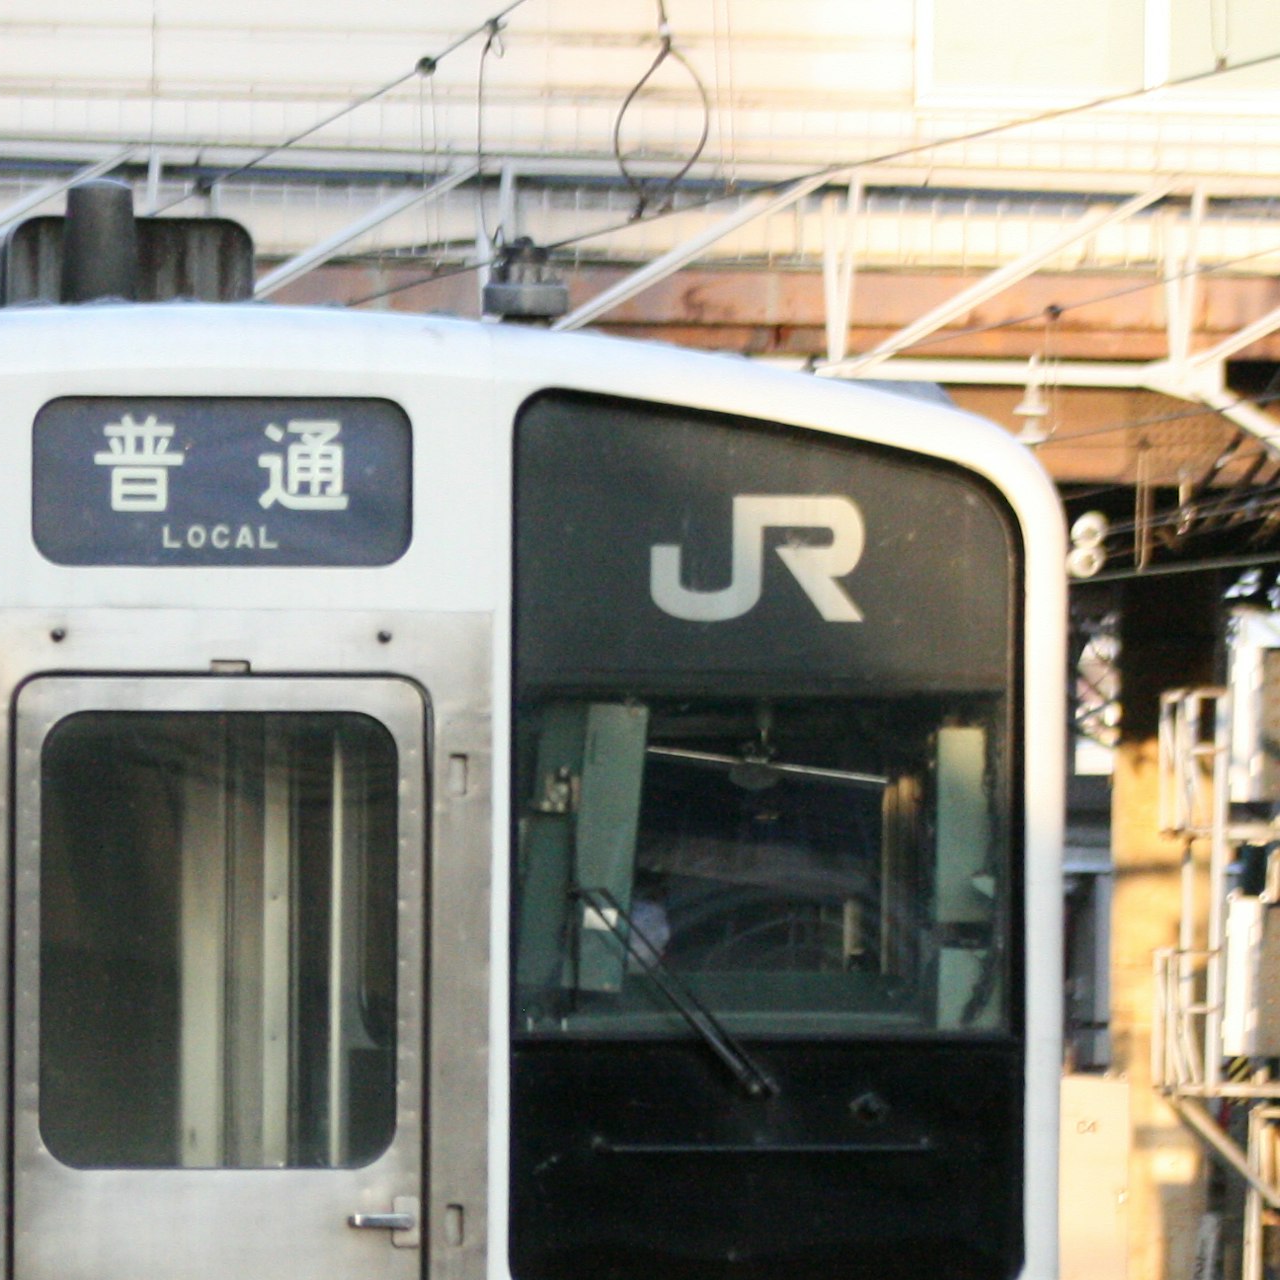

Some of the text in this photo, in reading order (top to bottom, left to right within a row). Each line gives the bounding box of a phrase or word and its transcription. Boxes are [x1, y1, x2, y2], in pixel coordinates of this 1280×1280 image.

[93, 413, 350, 513] 普通
[162, 524, 279, 550] LOCAL
[650, 494, 866, 623] JR
